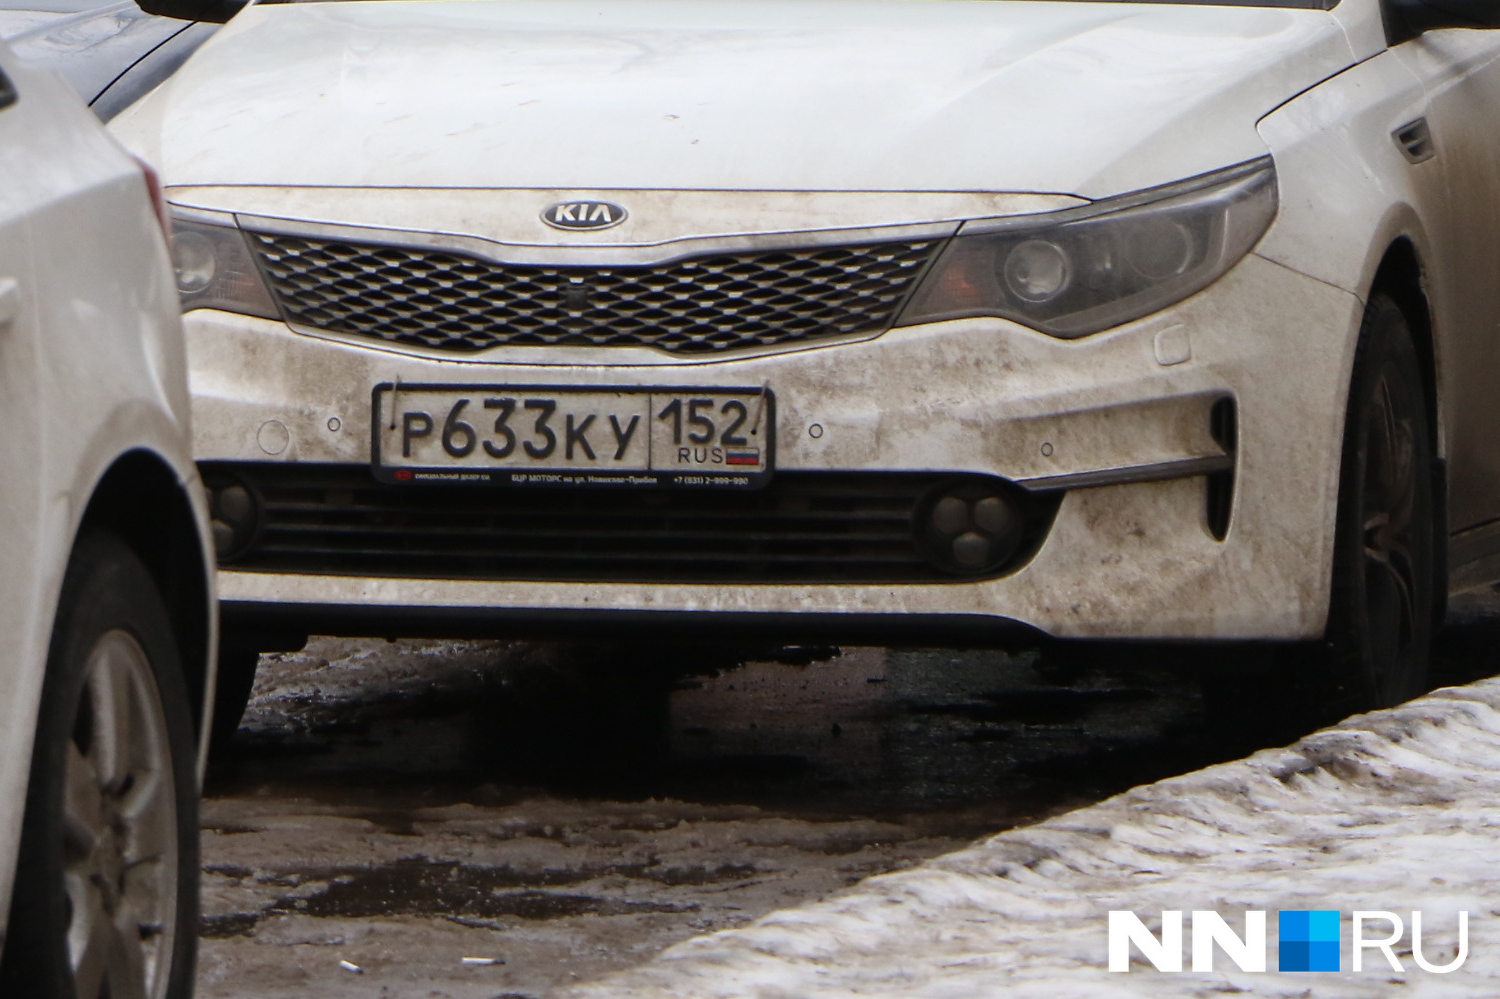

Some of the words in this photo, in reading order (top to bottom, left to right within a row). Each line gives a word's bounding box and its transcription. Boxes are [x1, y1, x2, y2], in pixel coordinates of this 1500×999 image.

[555, 203, 611, 222] KIA
[658, 399, 747, 445] 152
[678, 447, 723, 463] RUS
